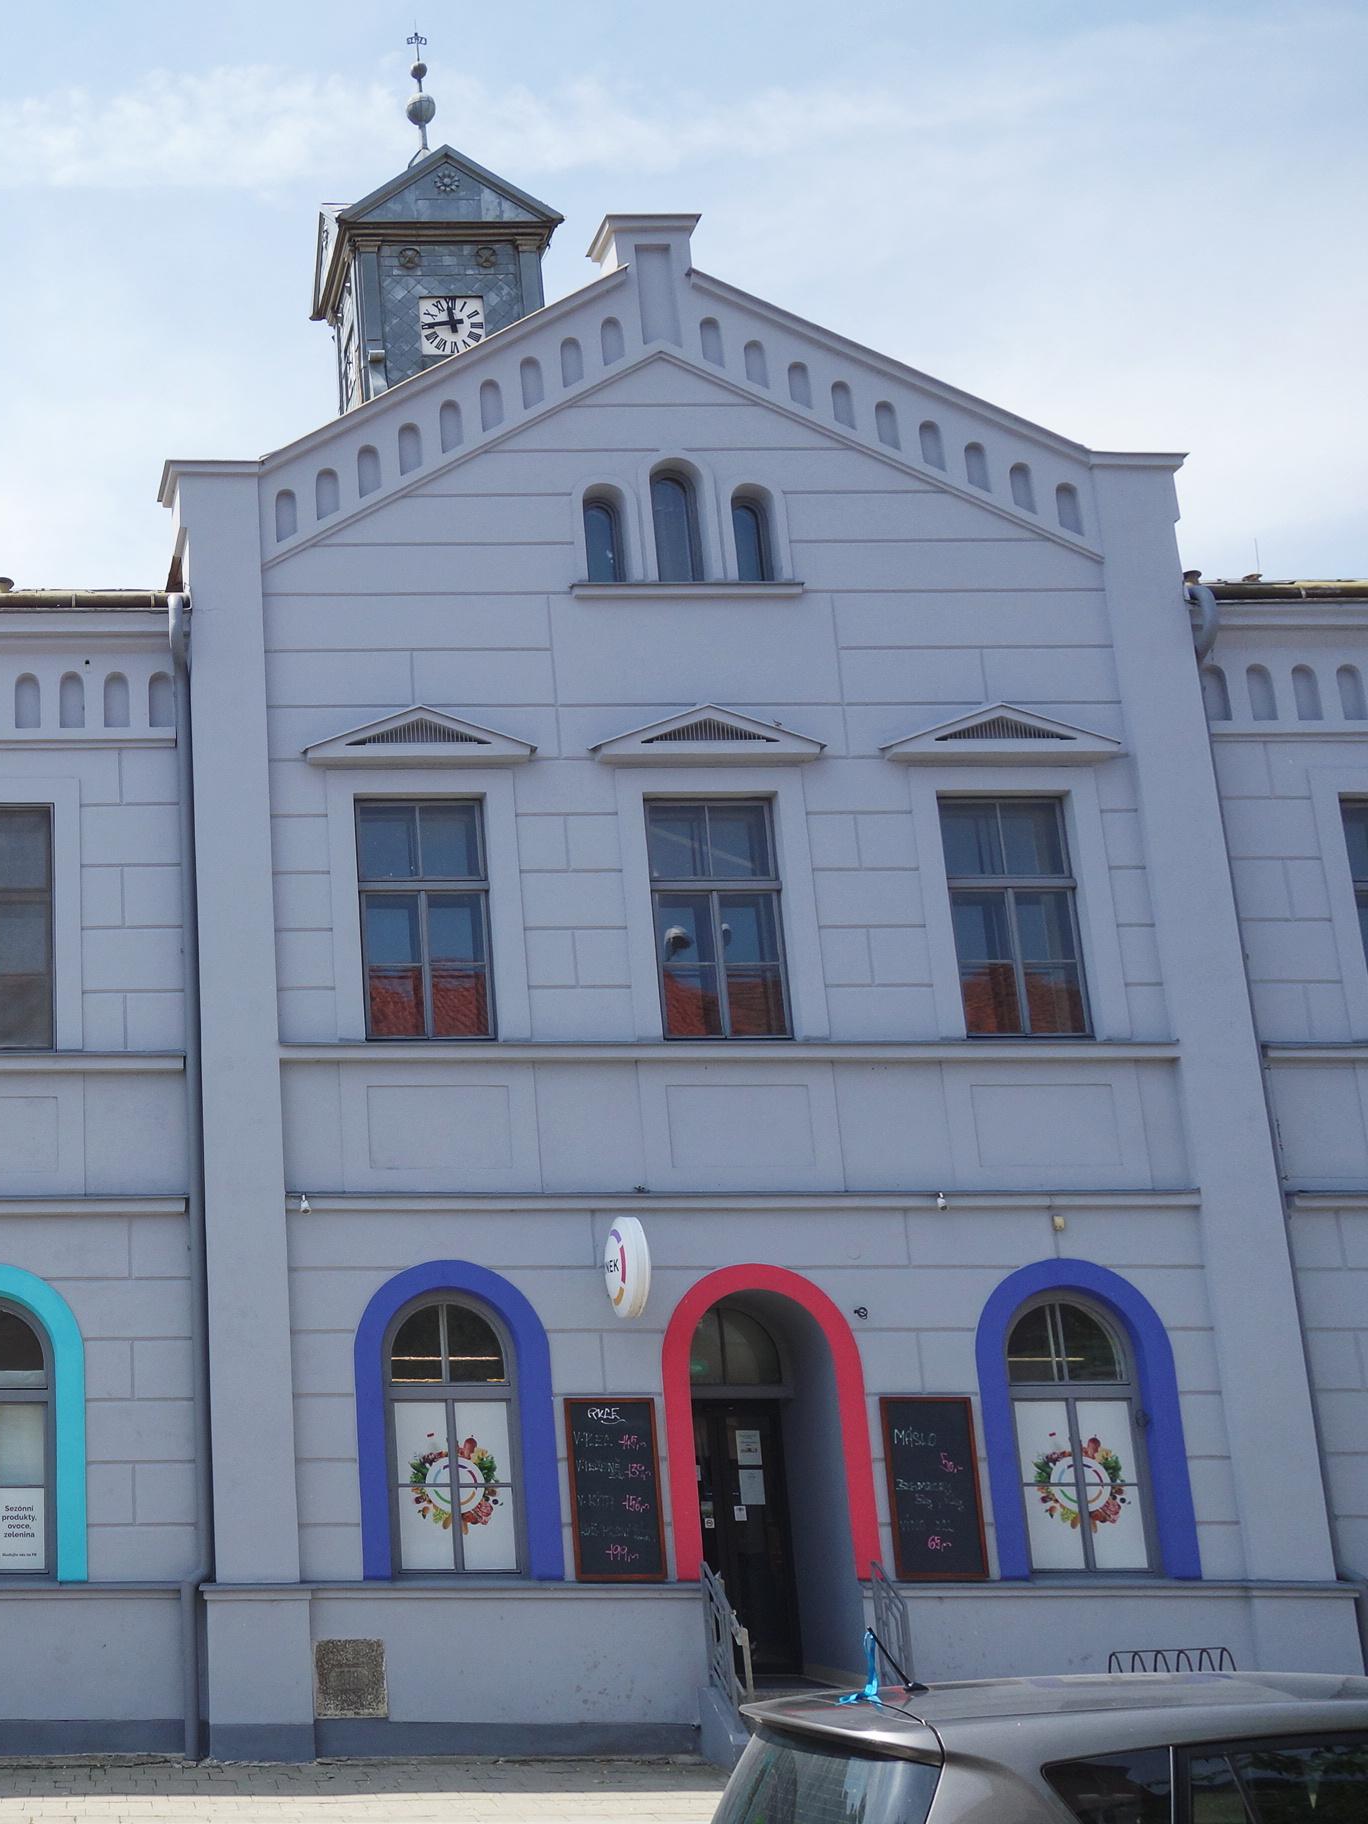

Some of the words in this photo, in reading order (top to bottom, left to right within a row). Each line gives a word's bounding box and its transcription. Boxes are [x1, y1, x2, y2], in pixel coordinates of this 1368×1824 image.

[423, 309, 438, 320] X
[466, 310, 480, 319] II
[1, 1514, 37, 1522] produkty,
